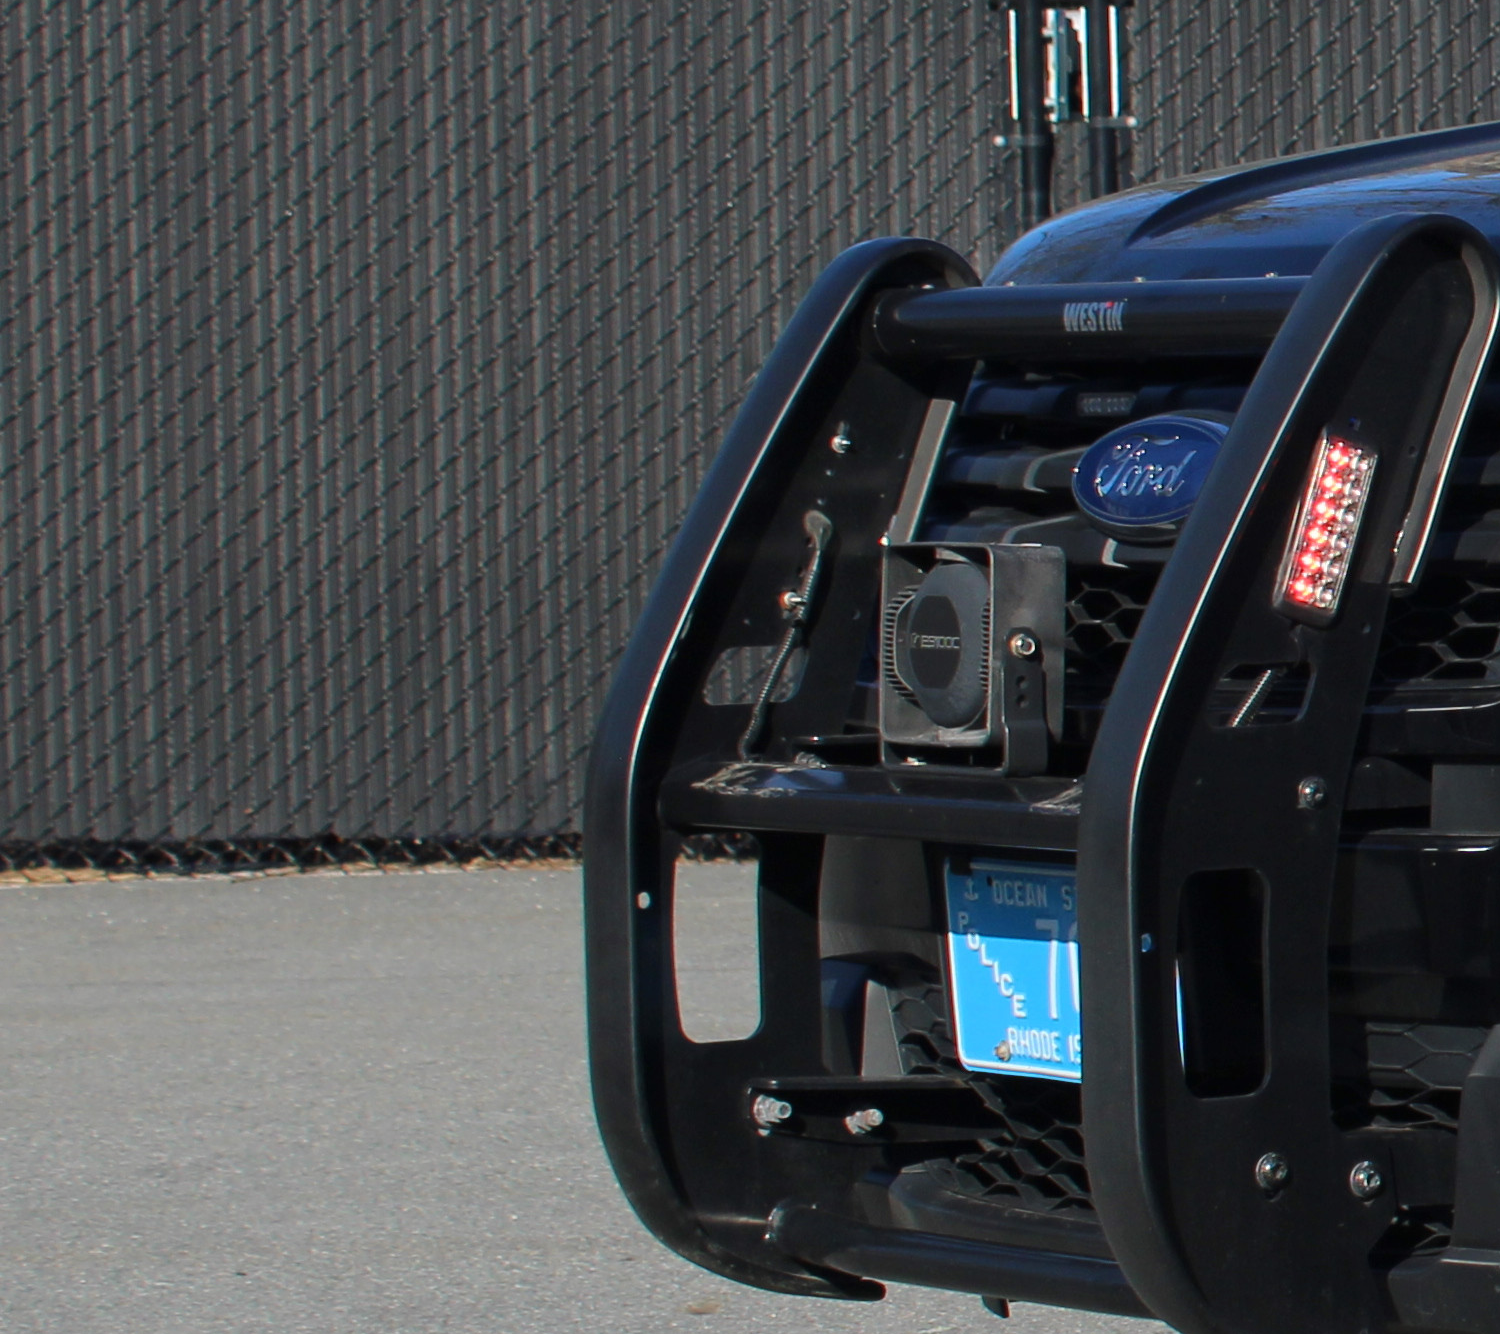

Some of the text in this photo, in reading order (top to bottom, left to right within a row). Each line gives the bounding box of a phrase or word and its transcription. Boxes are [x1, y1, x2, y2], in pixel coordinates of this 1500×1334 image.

[1095, 435, 1197, 498] Ford
[992, 878, 1048, 908] OCEAN
[956, 910, 1027, 1019] POLICE
[1006, 1026, 1061, 1063] RHODE
